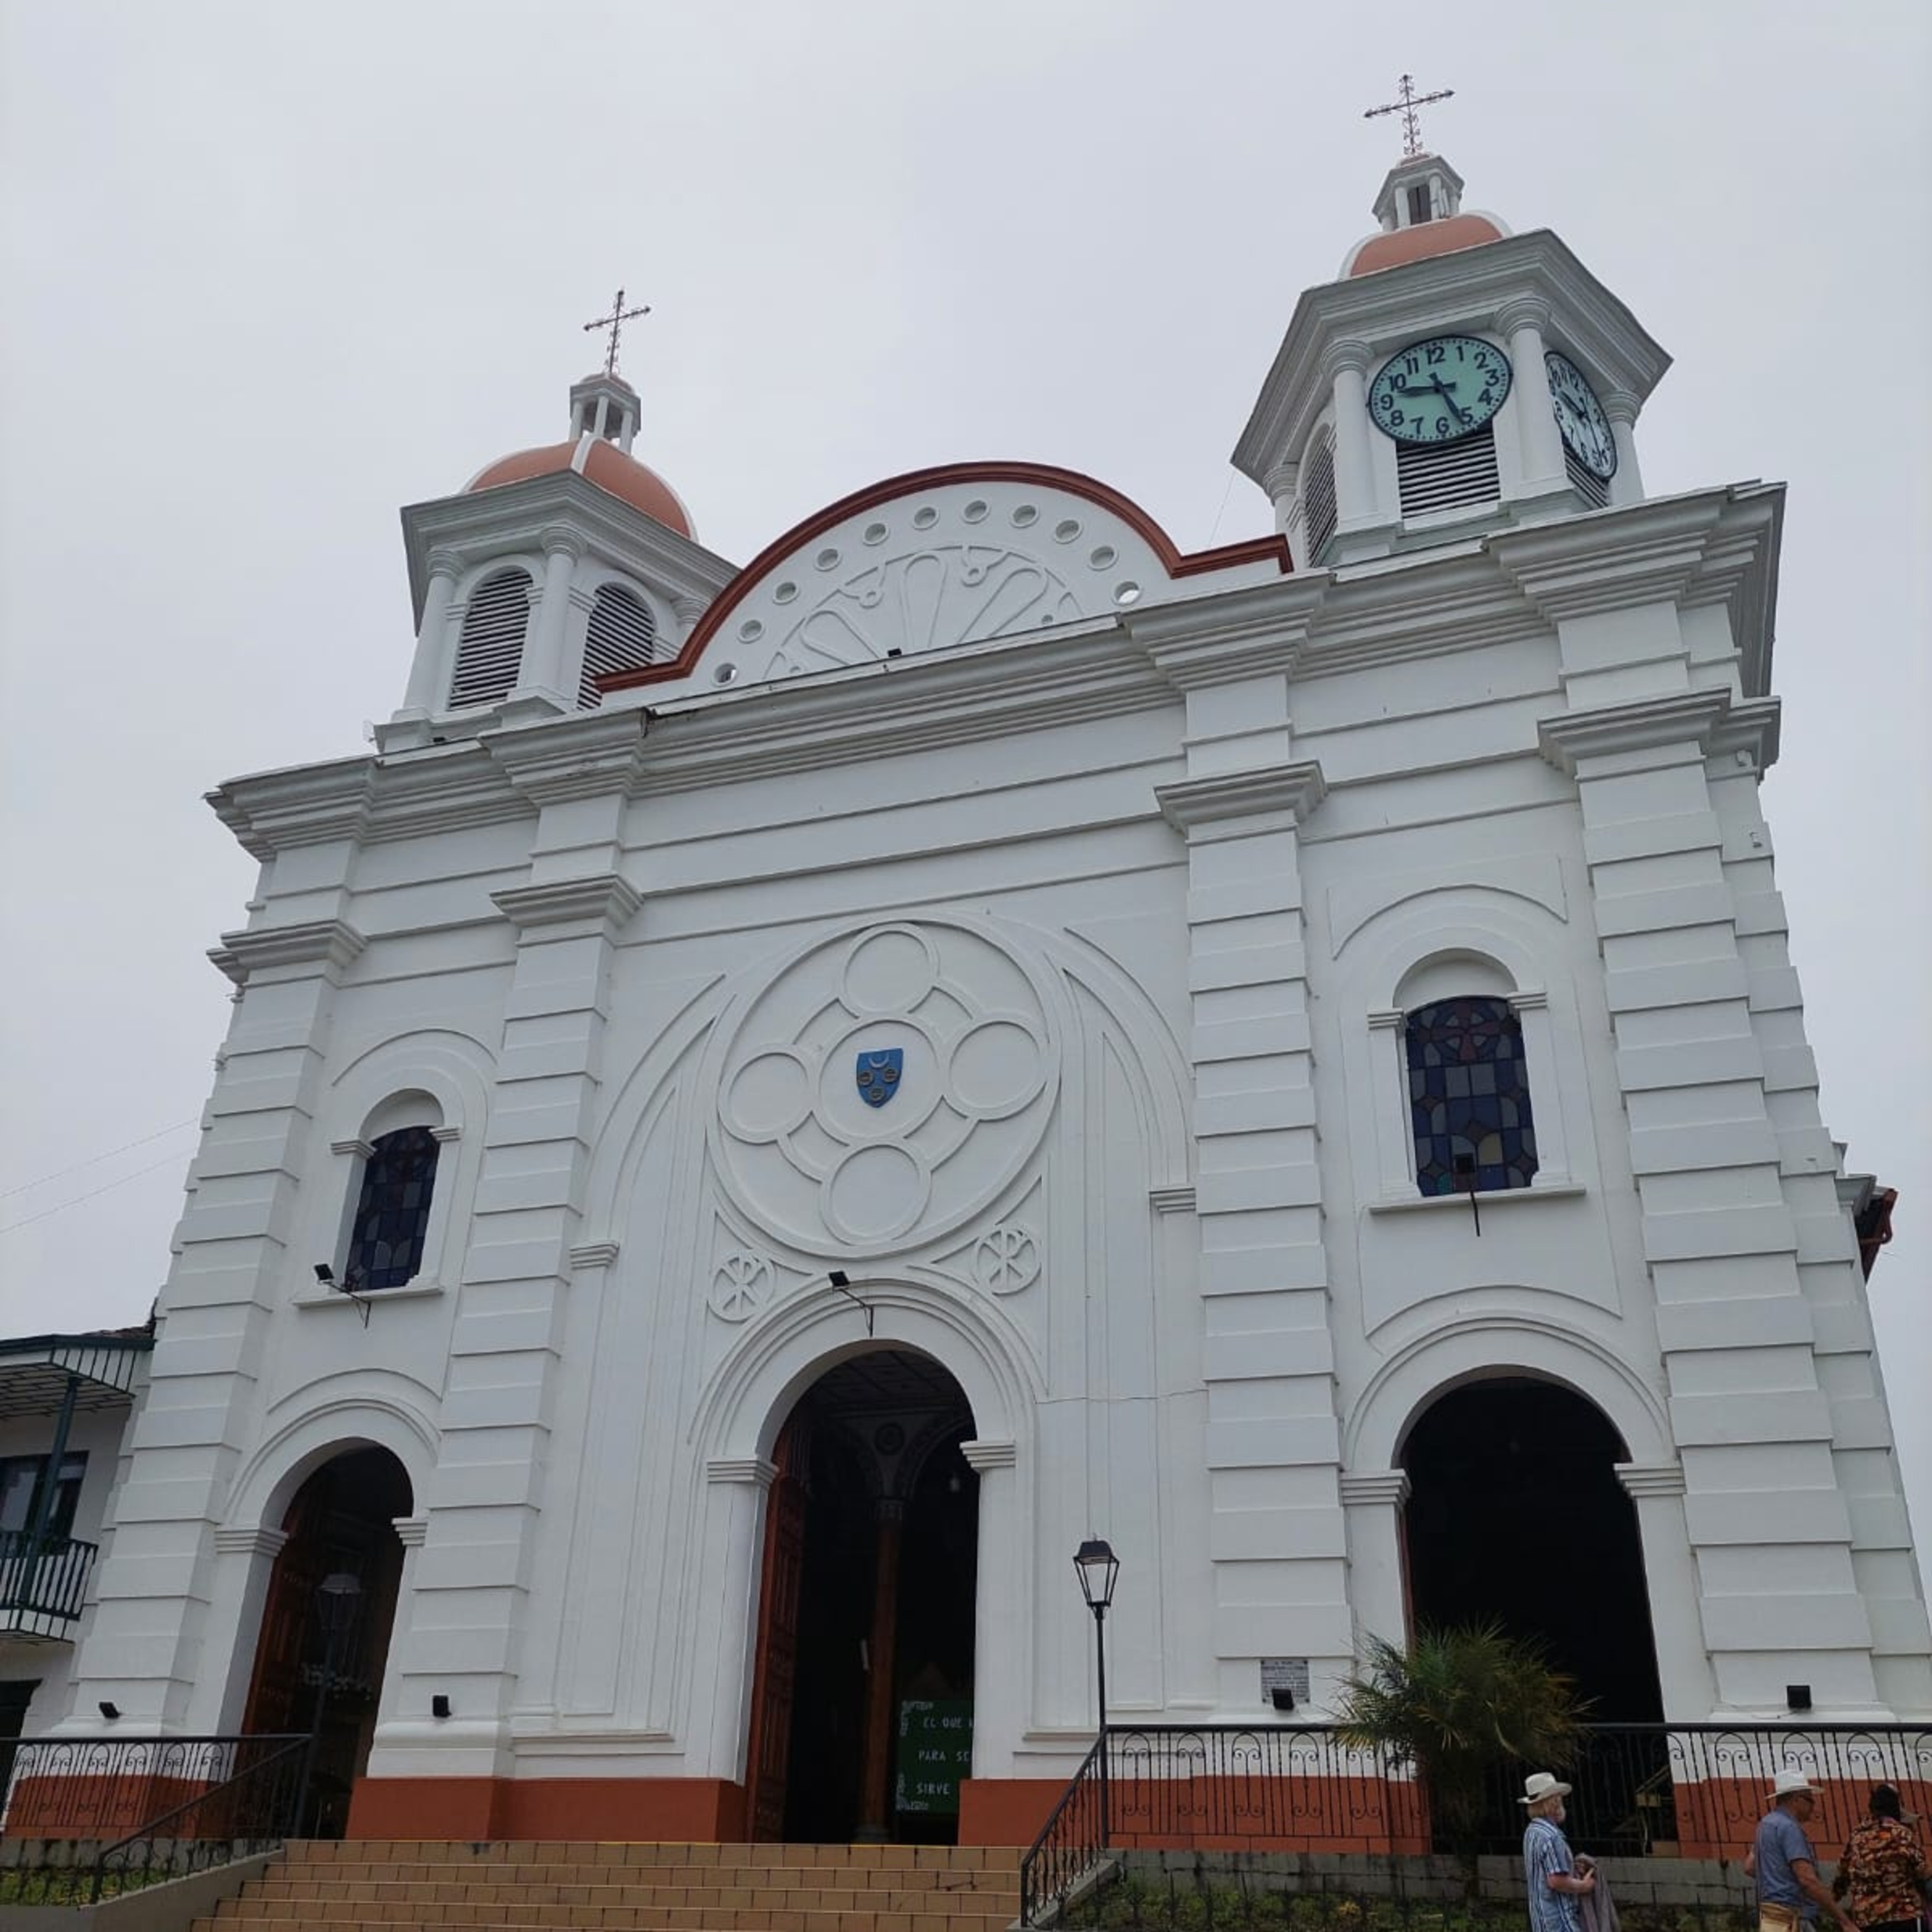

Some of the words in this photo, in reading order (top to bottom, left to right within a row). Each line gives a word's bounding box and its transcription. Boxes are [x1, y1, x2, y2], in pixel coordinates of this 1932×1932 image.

[1426, 346, 1446, 365] 12
[1456, 346, 1464, 361] 1
[1474, 352, 1489, 369] 2
[1406, 357, 1419, 375] 11
[1388, 374, 1406, 392] 10
[1485, 368, 1499, 386] 3
[1380, 394, 1393, 410] 9
[1478, 388, 1493, 405] 4
[1390, 410, 1404, 426] 8
[1460, 407, 1473, 424] 5
[1410, 417, 1424, 434] 7
[1436, 417, 1449, 434] 6
[918, 1750, 946, 1761] PARA
[916, 1783, 950, 1794] SIRVE
